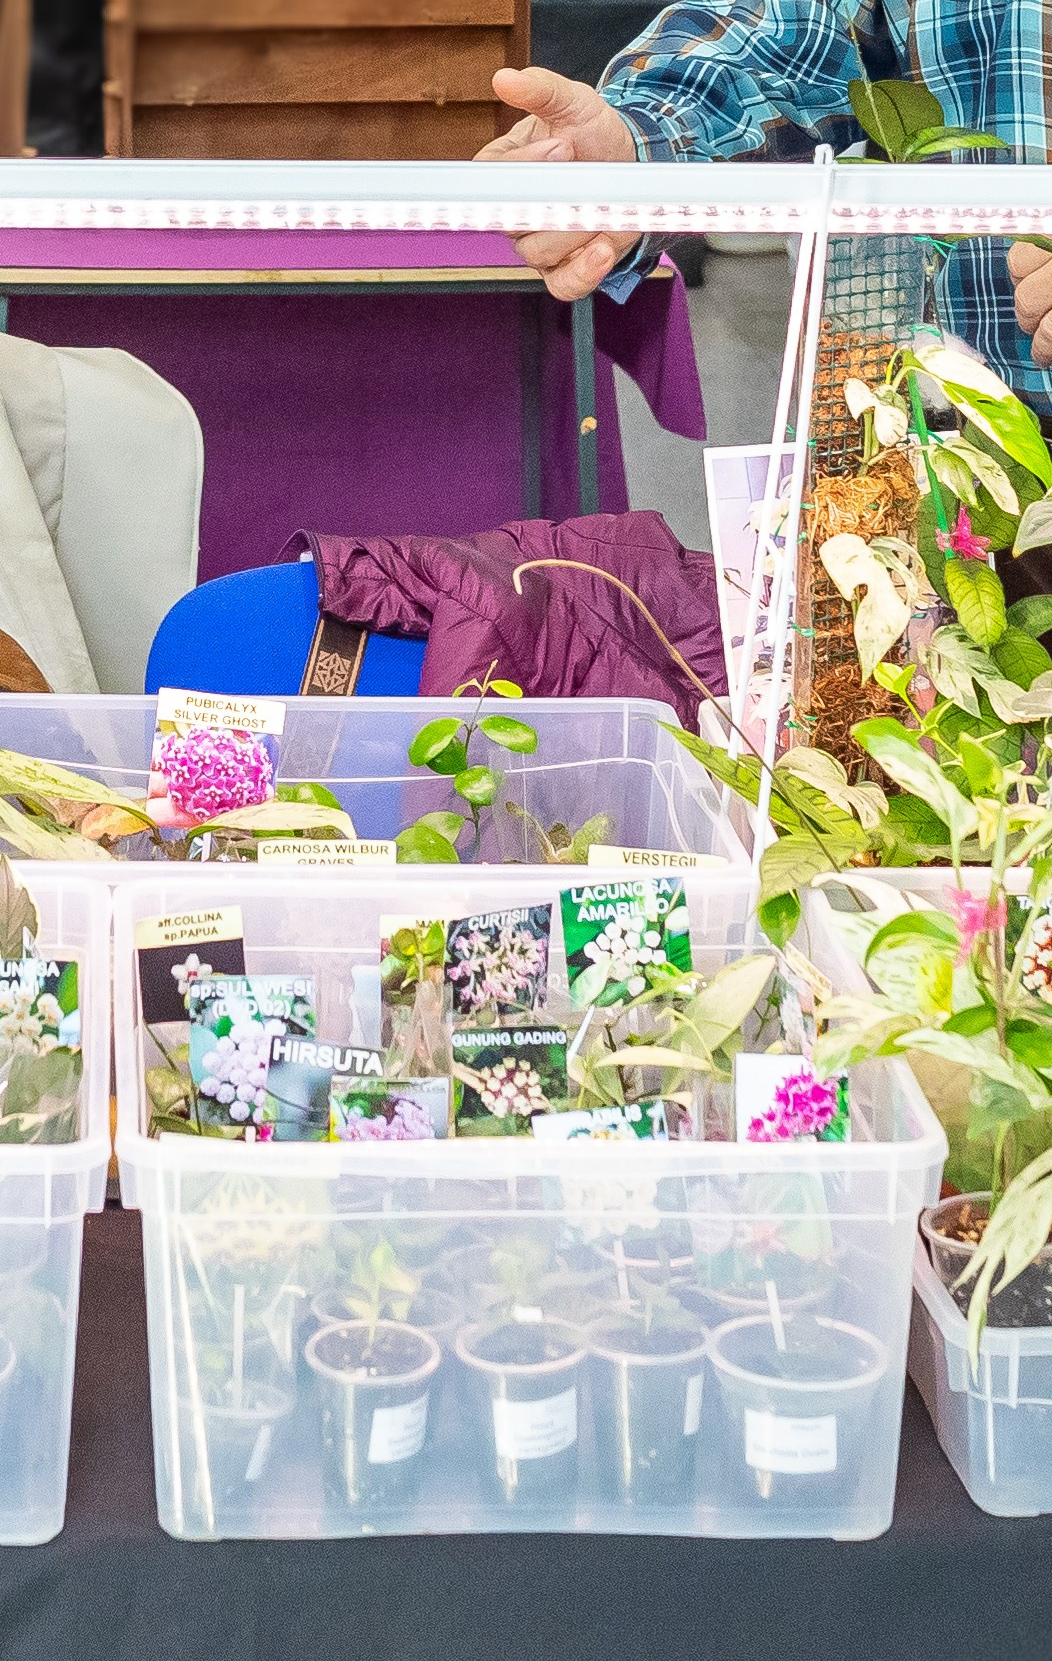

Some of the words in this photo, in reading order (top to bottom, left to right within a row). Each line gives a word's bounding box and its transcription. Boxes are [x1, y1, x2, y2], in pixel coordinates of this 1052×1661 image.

[186, 696, 257, 714] PUBICALYX
[174, 709, 218, 723] SILVER
[222, 715, 267, 729] GHOST
[262, 845, 330, 854] CARNOSA
[335, 845, 389, 855] WILBUR
[622, 851, 697, 867] VERSTEGII
[576, 897, 669, 923] AMARILO
[158, 912, 223, 928] aff.COLLINA
[468, 909, 529, 931] CURTISII
[164, 926, 219, 941] sp.PAPUA
[190, 979, 312, 1001] sp.SULWESI
[451, 1031, 512, 1047] GUNUNG
[513, 1030, 567, 1046] GADING
[273, 1038, 384, 1077] HIRSUTA
